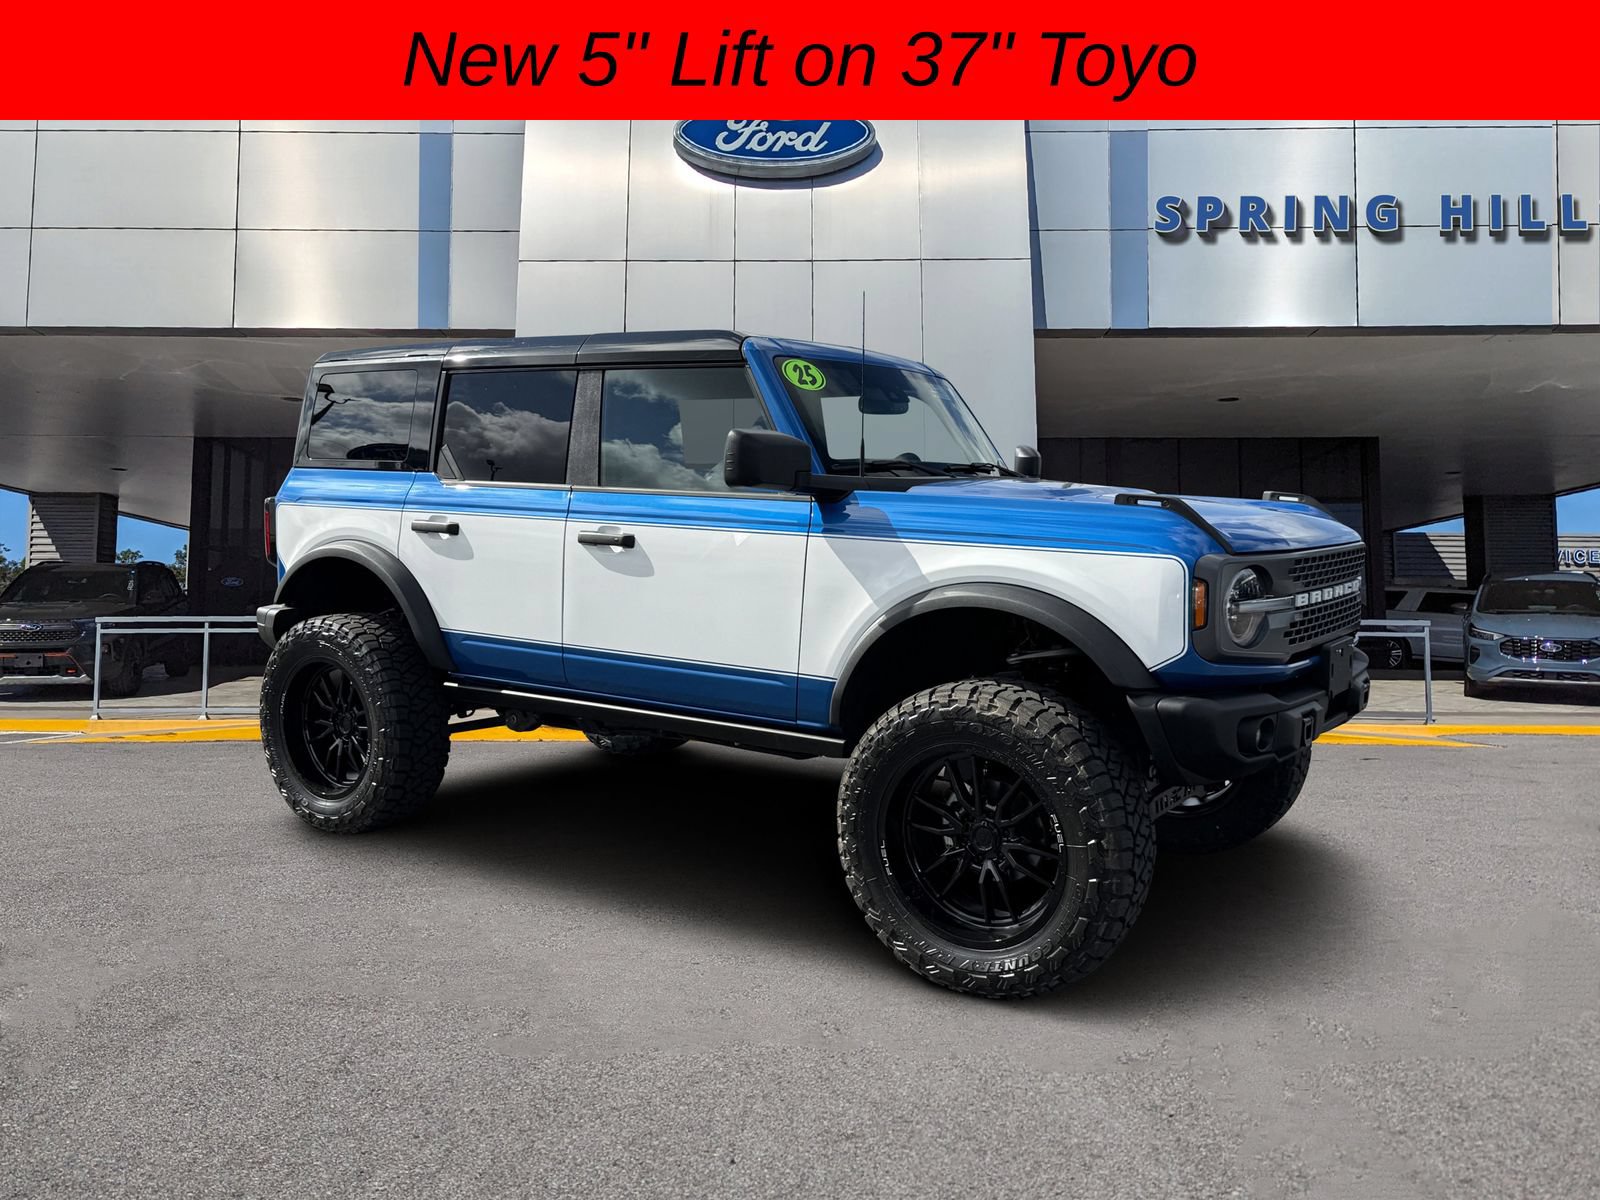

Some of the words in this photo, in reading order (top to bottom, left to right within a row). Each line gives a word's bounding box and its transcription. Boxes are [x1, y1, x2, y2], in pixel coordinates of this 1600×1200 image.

[715, 120, 831, 153] Ford
[1154, 194, 1400, 233] SPRING
[1440, 194, 1589, 233] HILL
[792, 364, 818, 386] 25
[1294, 579, 1361, 607] BRONCO
[1050, 813, 1065, 854] FUEL
[880, 839, 893, 876] FUEL
[958, 938, 1054, 973] COUNTRY
